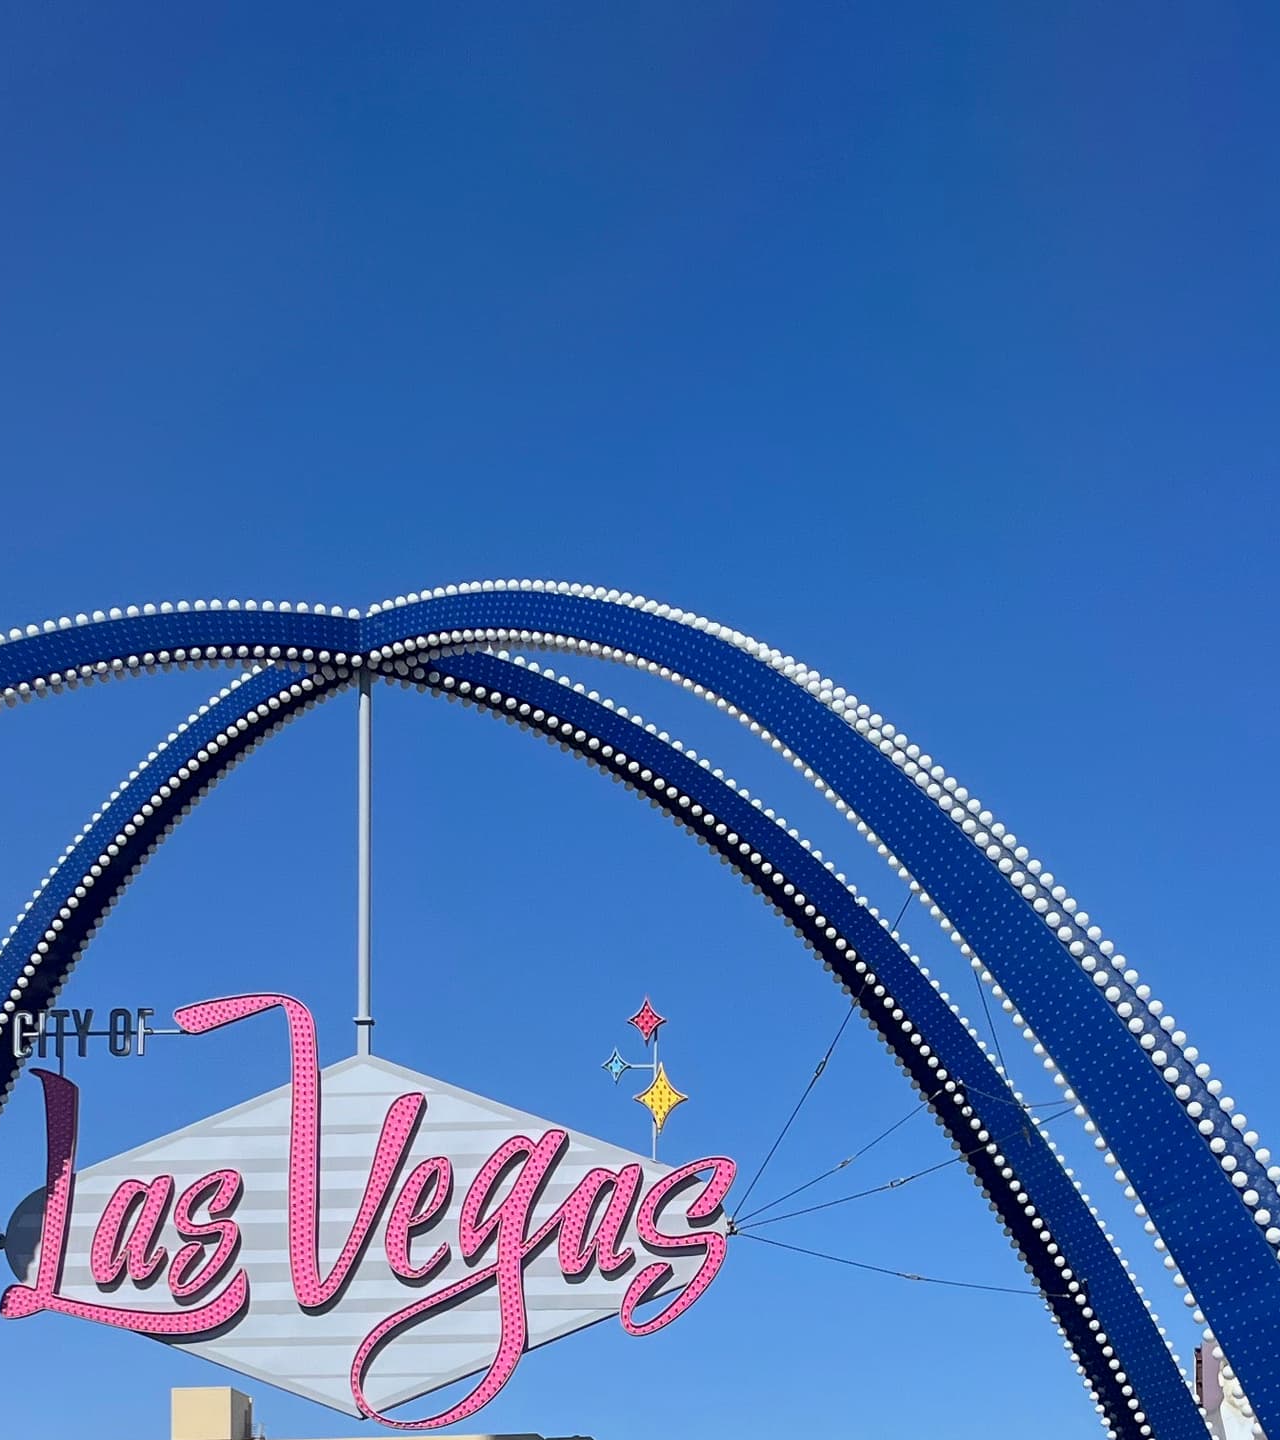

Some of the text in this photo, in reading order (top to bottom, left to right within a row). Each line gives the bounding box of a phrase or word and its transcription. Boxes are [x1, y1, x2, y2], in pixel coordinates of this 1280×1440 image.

[14, 1008, 154, 1058] CITY OF
[0, 992, 737, 1430] Las Vegas
